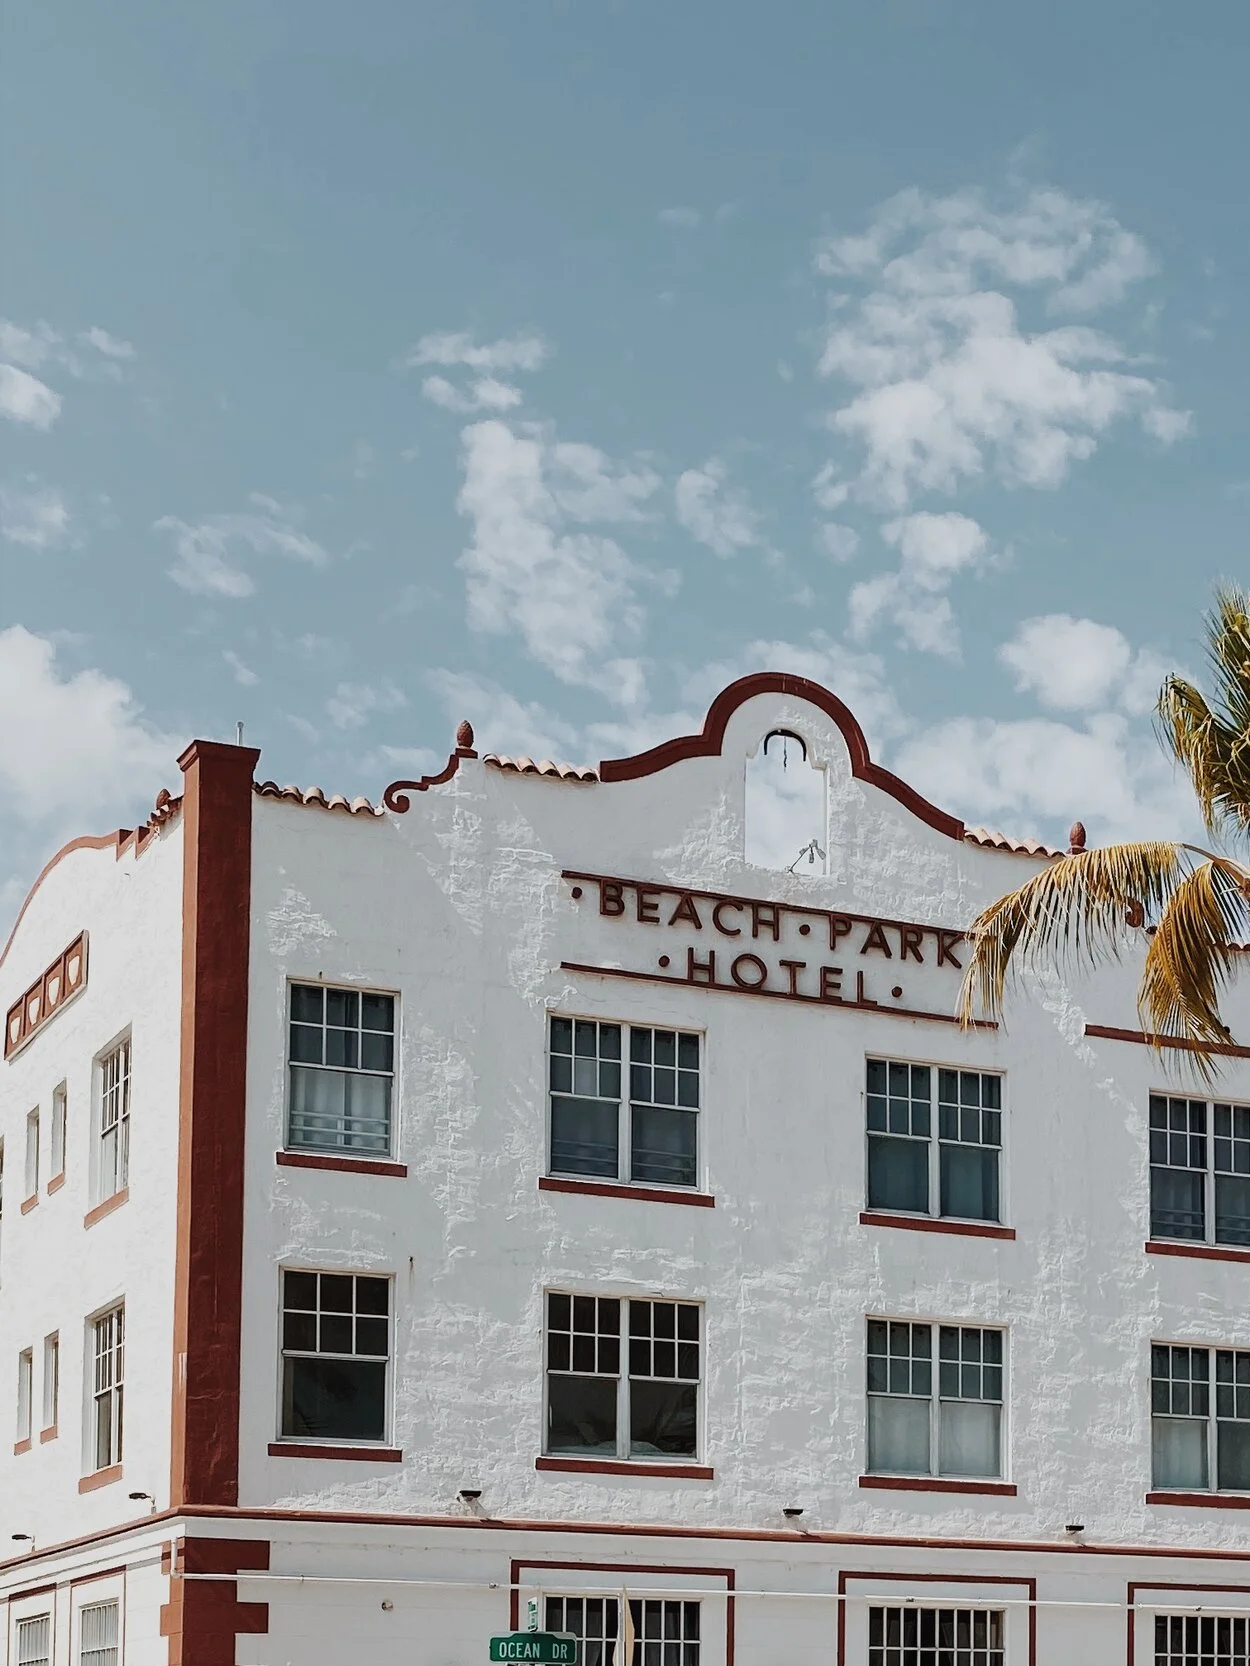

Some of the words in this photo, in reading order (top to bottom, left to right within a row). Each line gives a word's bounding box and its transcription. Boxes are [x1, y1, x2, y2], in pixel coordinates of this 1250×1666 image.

[600, 879, 780, 942] BEACH
[829, 913, 963, 969] PARK
[687, 947, 878, 1005] HOTEL
[499, 1642, 540, 1658] OCEAN
[552, 1643, 568, 1659] DR
